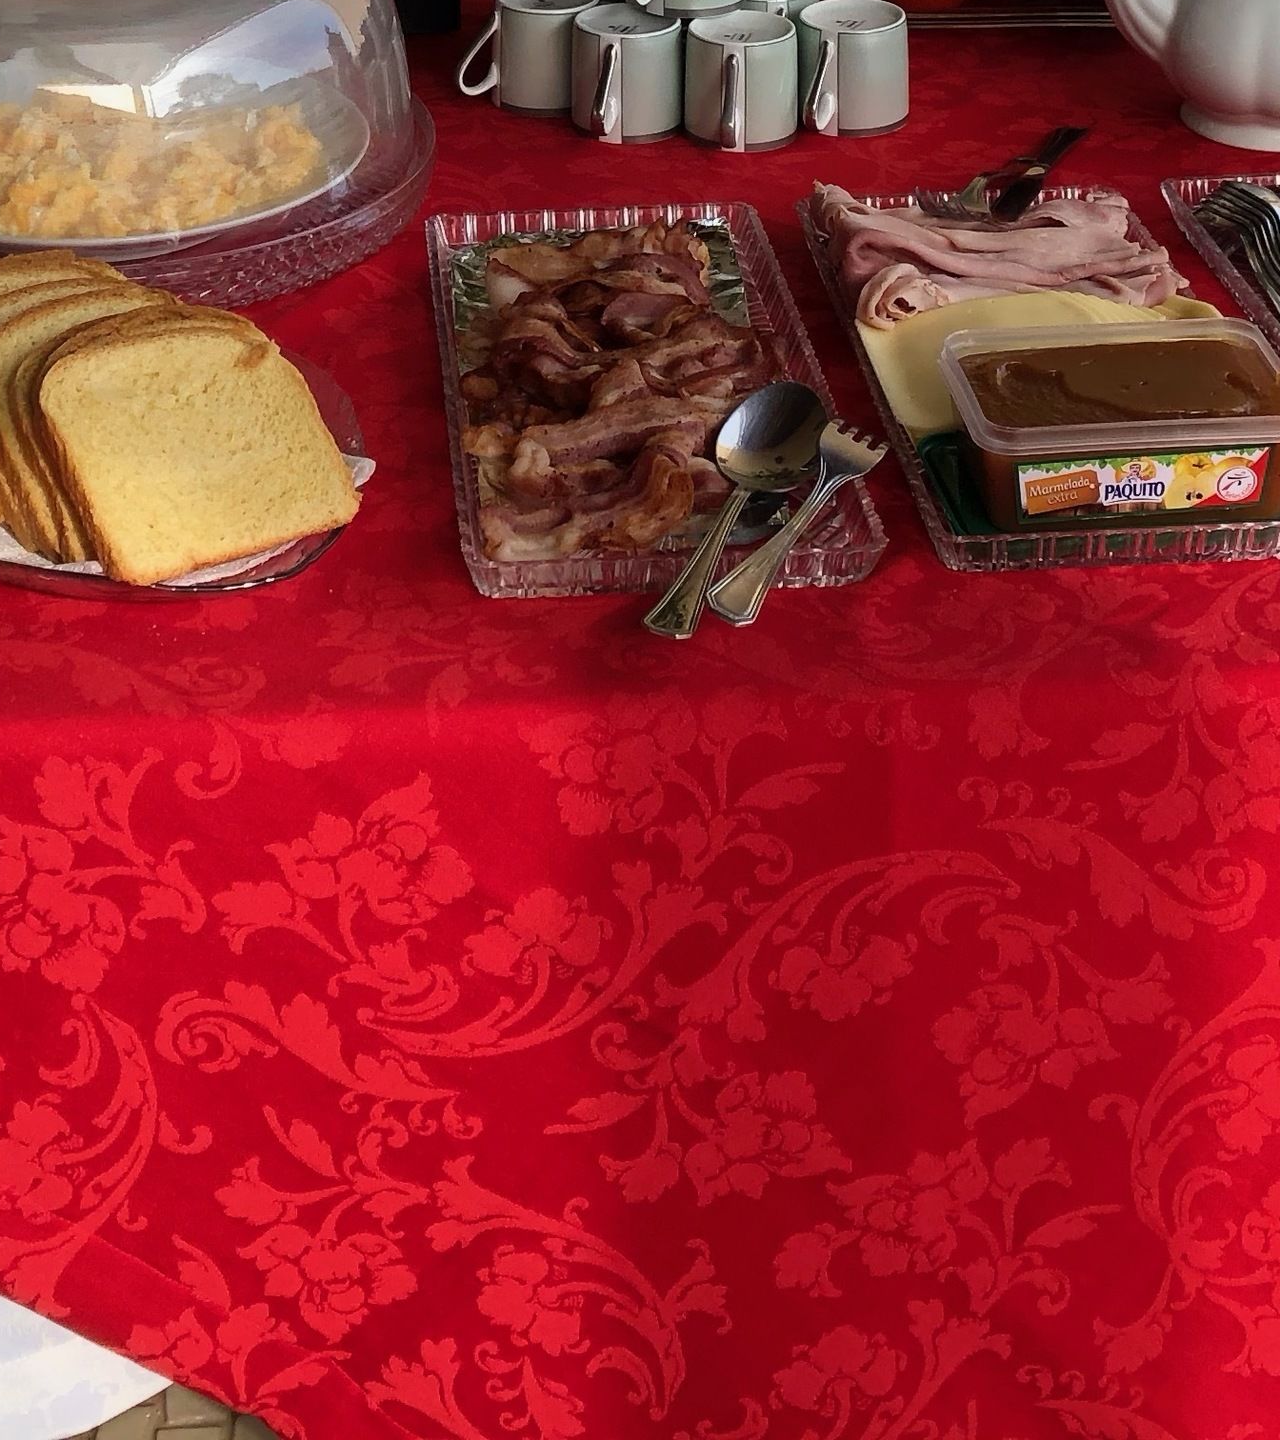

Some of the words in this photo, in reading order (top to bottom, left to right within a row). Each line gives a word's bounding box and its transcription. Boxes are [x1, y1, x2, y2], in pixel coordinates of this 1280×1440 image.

[1029, 476, 1090, 497] Marmelada
[1104, 481, 1166, 502] PAQUITO
[1047, 490, 1079, 505] extra
